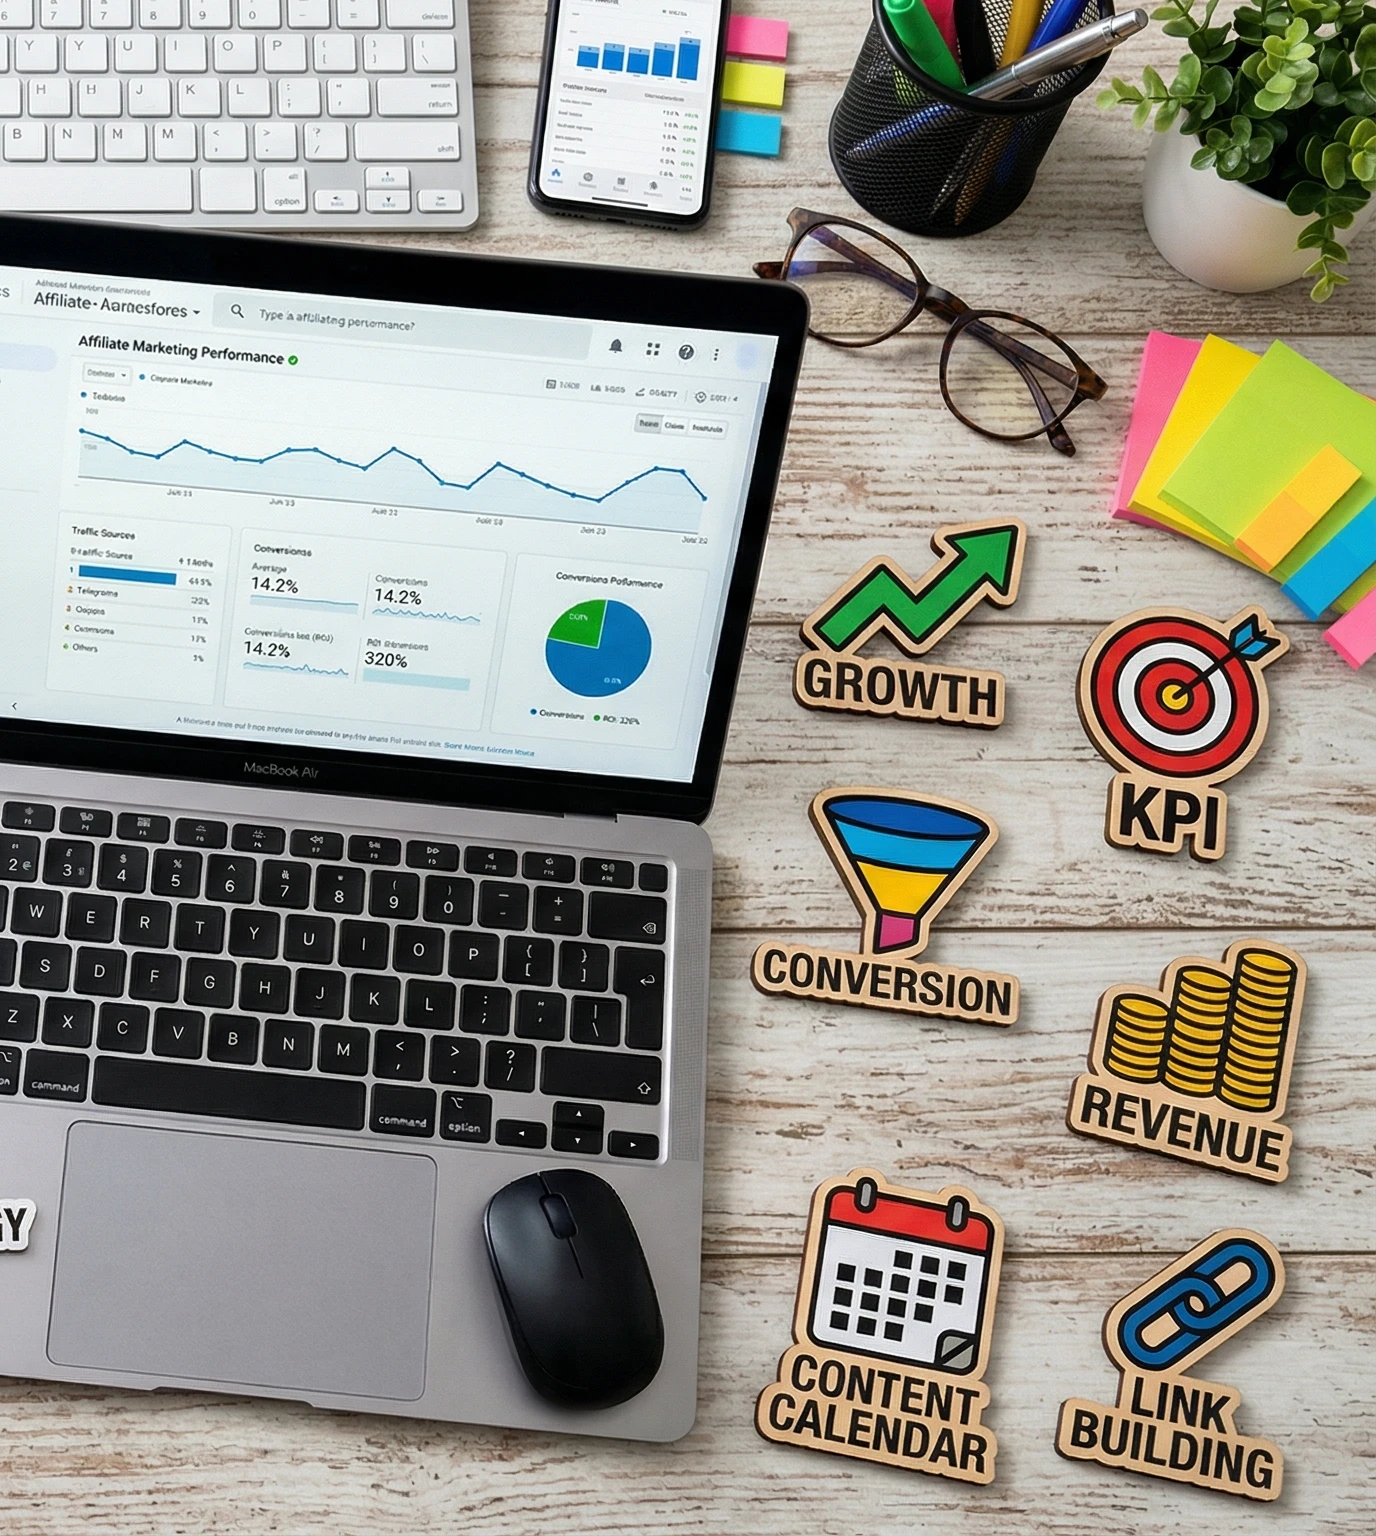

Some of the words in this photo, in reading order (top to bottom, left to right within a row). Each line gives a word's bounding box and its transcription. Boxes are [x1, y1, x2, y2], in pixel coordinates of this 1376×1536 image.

[0, 10, 7, 20] 6
[100, 11, 107, 20] 7
[149, 10, 157, 20] 8
[198, 10, 206, 20] 9
[248, 10, 256, 19] 0
[24, 39, 34, 50] Y
[122, 40, 132, 51] U
[174, 40, 177, 50] I
[221, 39, 233, 51] O
[272, 39, 282, 50] P
[36, 83, 45, 94] H
[135, 84, 142, 94] J
[185, 84, 195, 94] K
[236, 83, 244, 94] L
[12, 127, 21, 139] B
[62, 128, 71, 138] N
[112, 128, 122, 139] M
[162, 128, 173, 138] M
[78, 334, 129, 351] Affiliate
[132, 340, 197, 359] Marketing
[201, 346, 284, 365] Performance
[251, 576, 298, 593] 14.2%
[375, 588, 421, 605] 14.2%
[244, 641, 290, 658] 14.2%
[364, 651, 408, 668] 320%
[805, 658, 998, 718] GROWTH
[243, 762, 299, 778] MacBook
[1119, 782, 1219, 851] KPI
[8, 858, 17, 870] 2
[62, 863, 71, 876] 3
[116, 869, 126, 881] 4
[171, 874, 180, 886] 5
[225, 879, 234, 892] 6
[280, 884, 289, 897] 7
[334, 889, 344, 903] 8
[389, 895, 398, 908] 9
[443, 901, 453, 913] 0
[29, 904, 44, 917] W
[86, 910, 95, 923] E
[139, 915, 150, 928] R
[195, 920, 204, 934] T
[249, 926, 259, 939] Y
[303, 932, 314, 945] U
[362, 937, 365, 950] I
[413, 942, 424, 956] O
[468, 947, 478, 960] P
[39, 958, 50, 972] S
[94, 964, 105, 977] D
[150, 969, 159, 982] F
[204, 975, 215, 988] G
[259, 980, 270, 994] H
[315, 986, 324, 999] J
[369, 991, 379, 1005] K
[425, 997, 433, 1010] L
[762, 948, 1012, 1016] CONVERSION
[7, 1009, 18, 1022] Z
[62, 1014, 73, 1028] X
[117, 1020, 127, 1034] C
[172, 1025, 184, 1039] V
[227, 1031, 238, 1045] B
[283, 1037, 294, 1050] N
[336, 1042, 349, 1056] M
[1081, 1086, 1288, 1174] REVENUE
[791, 1353, 980, 1426] CONTENT
[1130, 1376, 1231, 1433] LINK
[768, 1391, 988, 1474] CALENDAR
[1069, 1410, 1275, 1490] BUILDING
